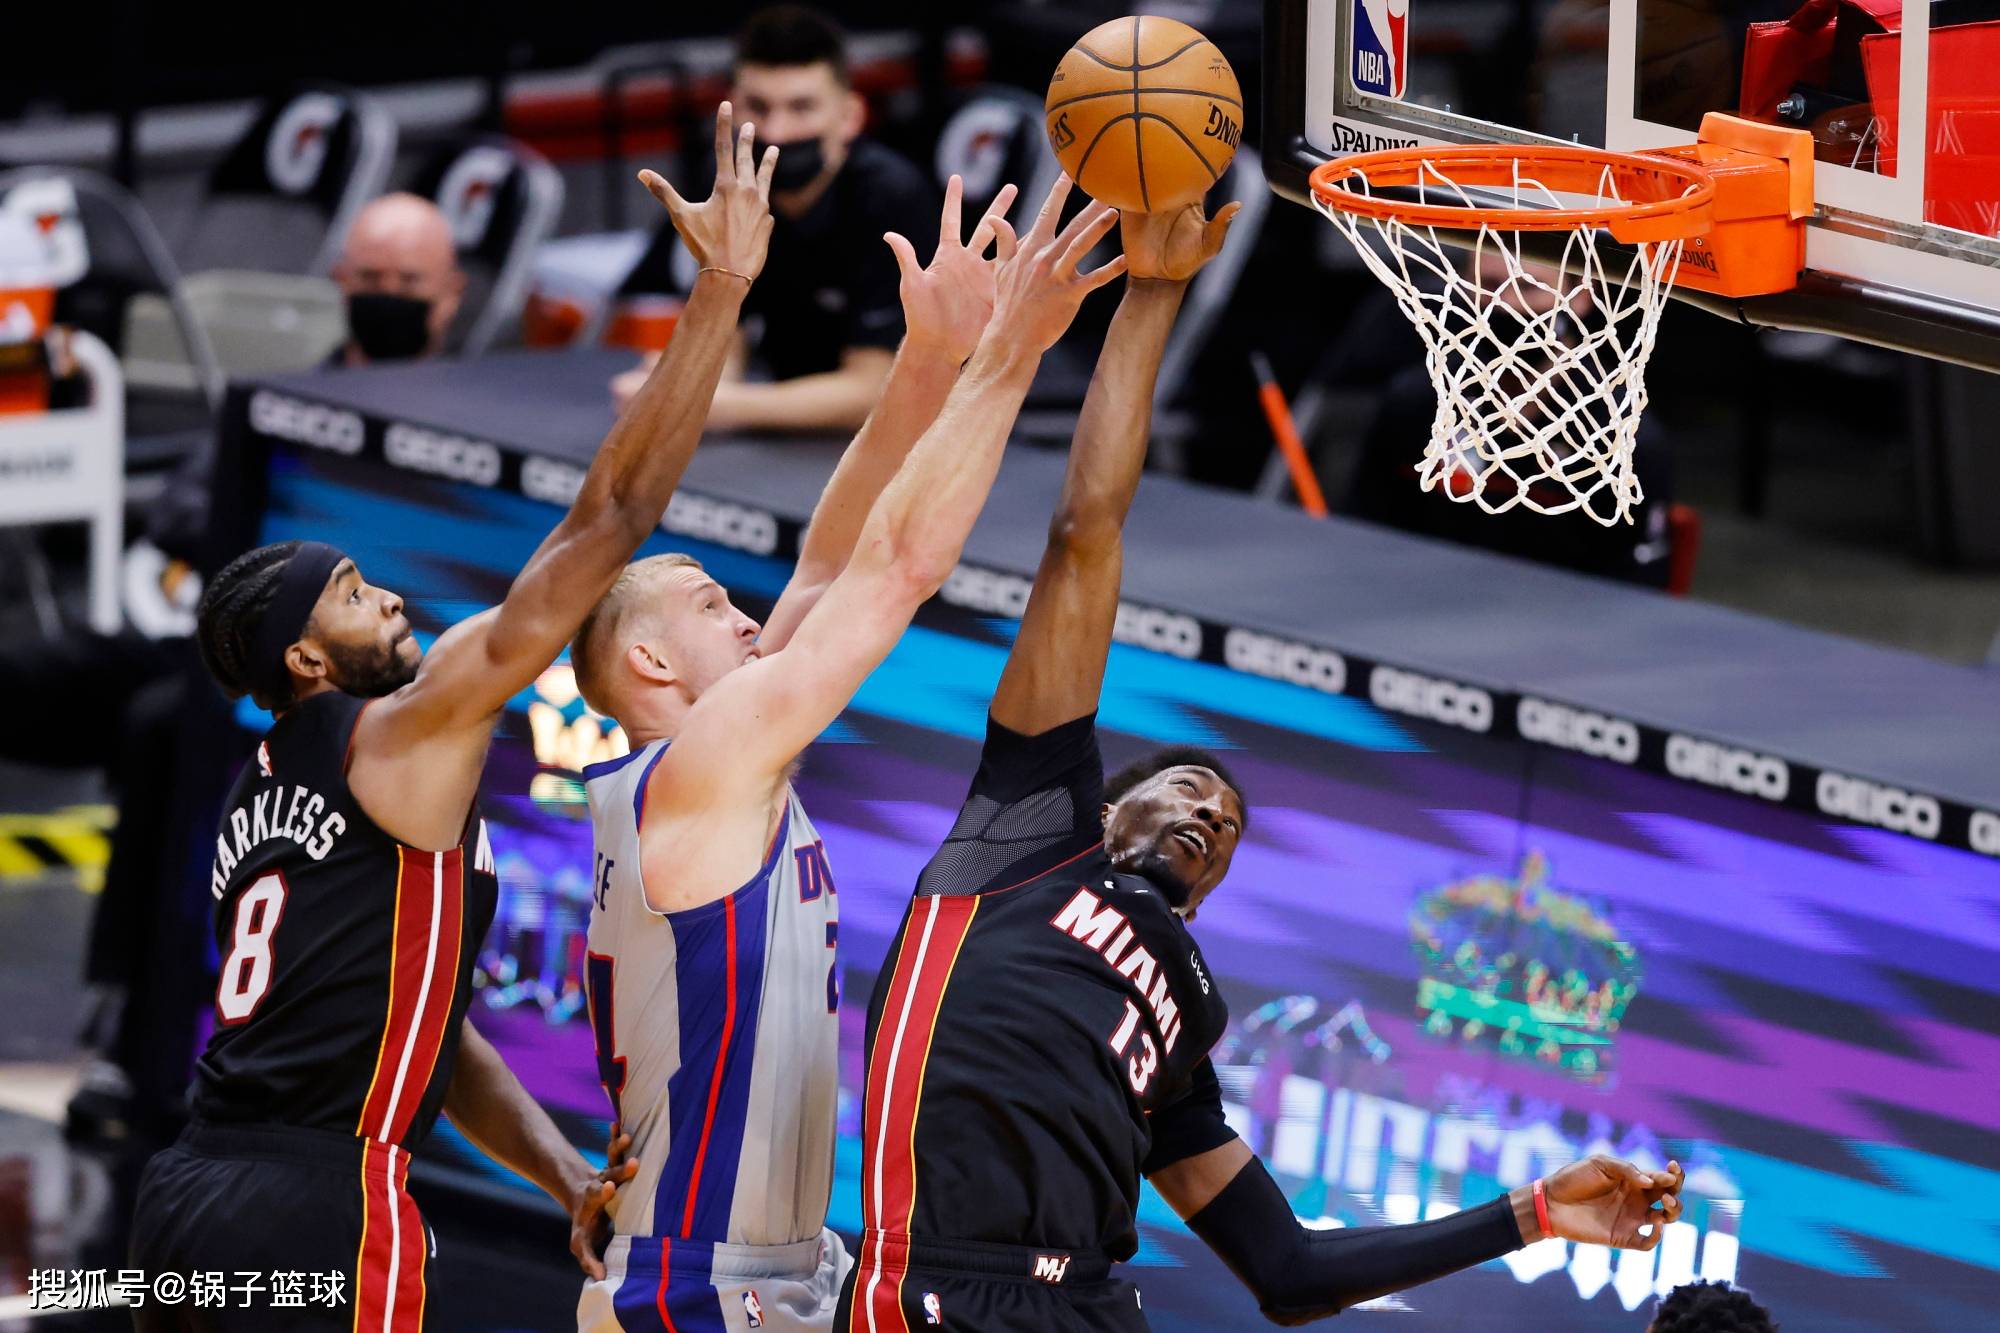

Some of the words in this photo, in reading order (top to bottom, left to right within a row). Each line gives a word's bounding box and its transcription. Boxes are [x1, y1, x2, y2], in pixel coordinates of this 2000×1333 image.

[1358, 50, 1384, 86] NBA
[1224, 627, 1347, 694] GEICO
[1369, 665, 1493, 732] GEICO
[1516, 697, 1640, 764] GEICO
[1664, 733, 1789, 801] GEICO
[1815, 770, 1941, 840] GEICO
[215, 866, 290, 1026] 8
[1050, 885, 1181, 1057] MIAMI
[1107, 996, 1158, 1094] 13
